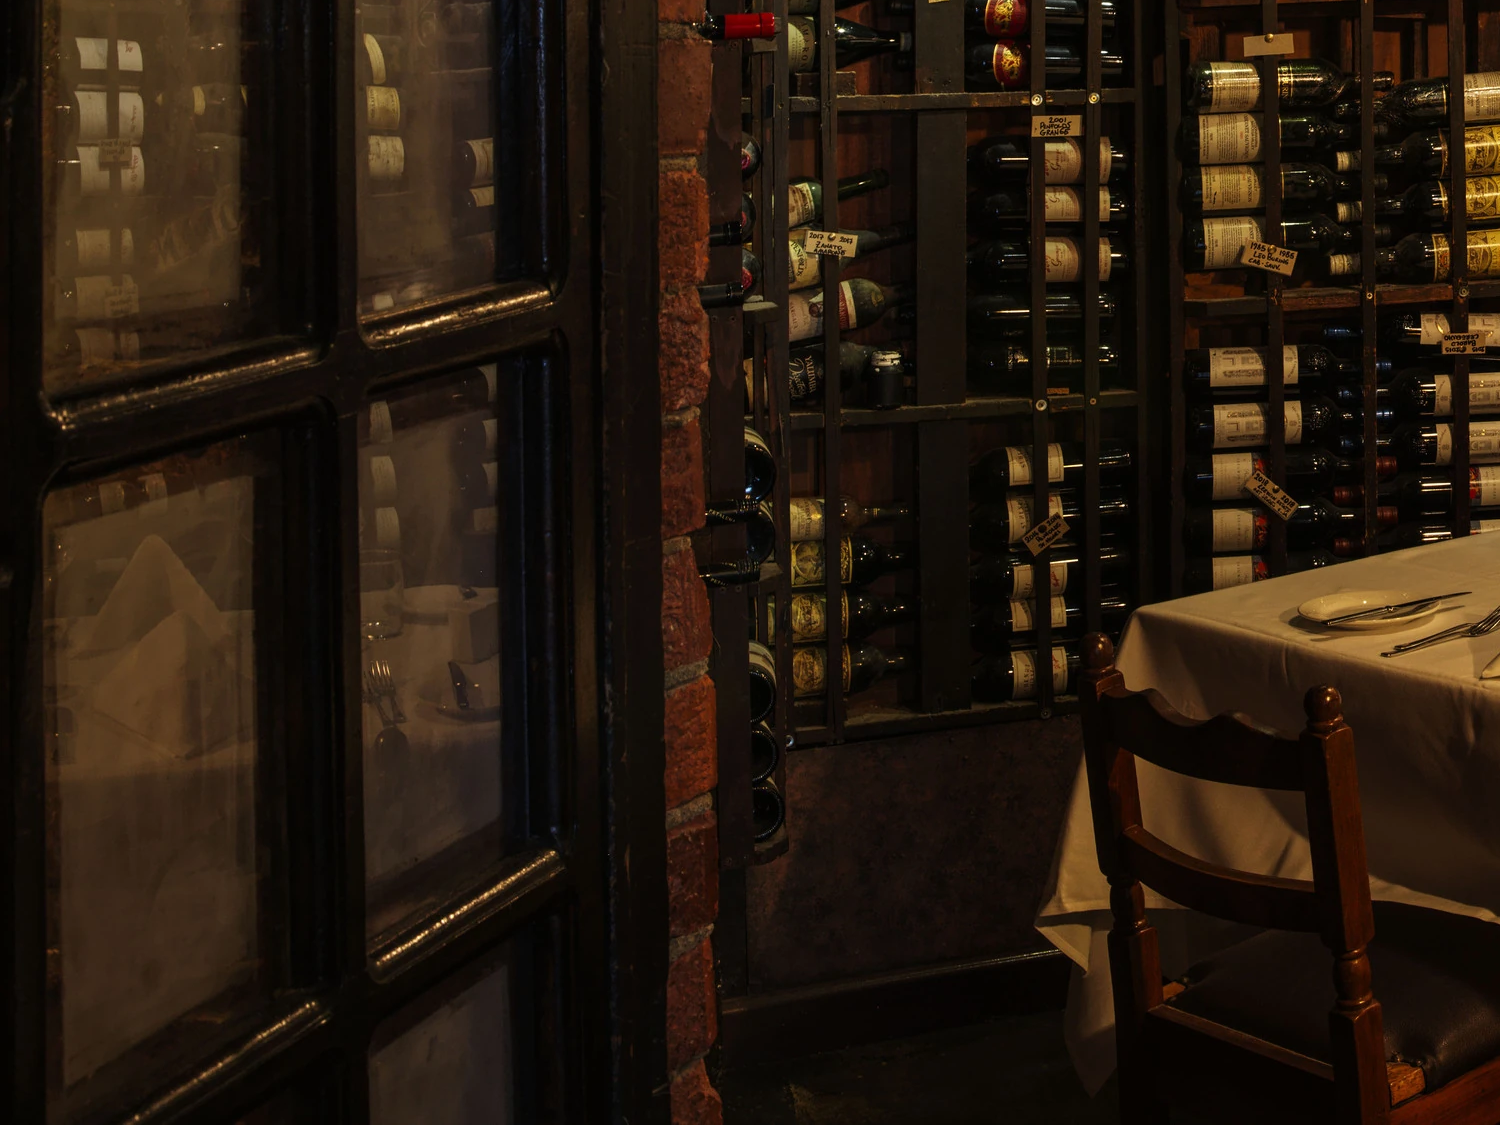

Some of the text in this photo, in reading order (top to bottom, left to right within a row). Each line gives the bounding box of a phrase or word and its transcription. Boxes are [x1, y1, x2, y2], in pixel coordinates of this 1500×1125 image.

[1049, 116, 1067, 124] 2001
[1253, 251, 1289, 265] LEO BURING
[804, 355, 817, 394] YALUMBA
